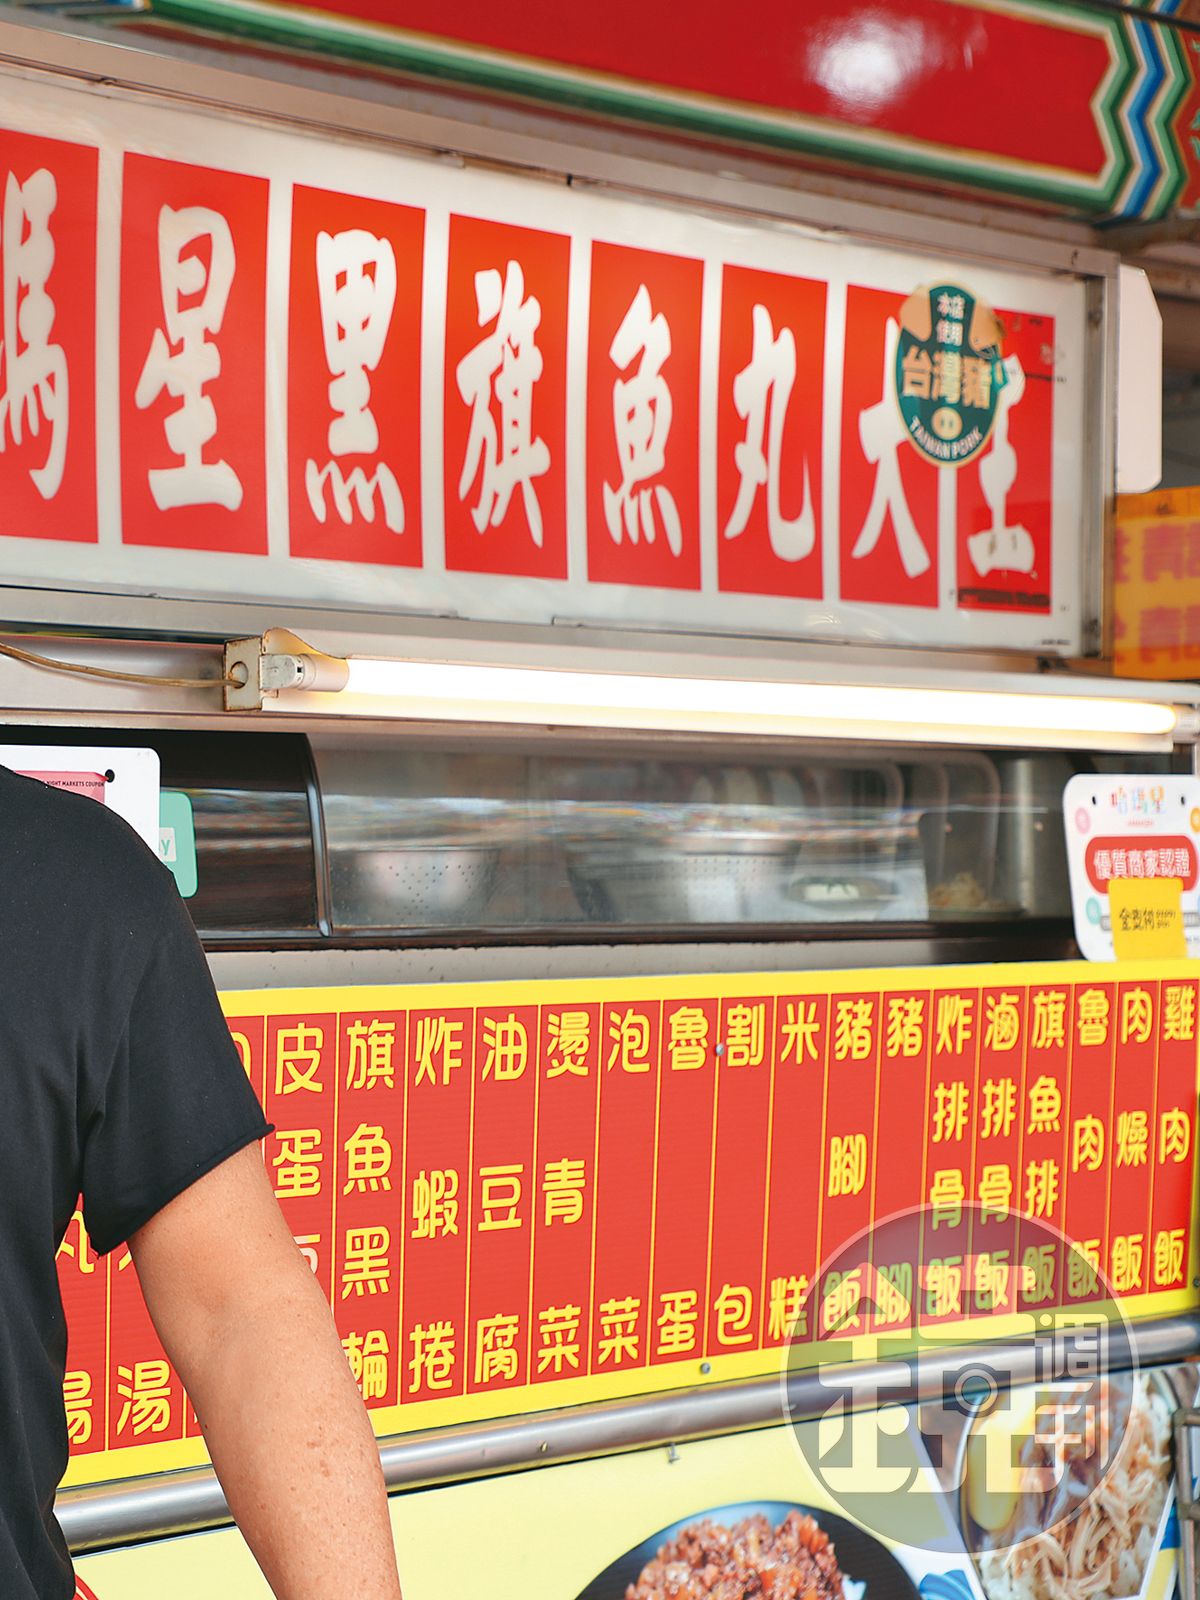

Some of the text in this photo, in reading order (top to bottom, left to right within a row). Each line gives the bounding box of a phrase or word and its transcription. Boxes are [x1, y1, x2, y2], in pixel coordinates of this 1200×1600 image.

[902, 345, 992, 410] 台灣豬
[909, 416, 983, 459] TAIWAN PORK
[1094, 848, 1191, 879] 優質商家認證
[341, 1019, 397, 1400] 旗魚黑輪
[409, 1017, 464, 1393] 炸蝦捲
[474, 1013, 529, 1383] 油豆腐
[537, 1011, 591, 1374] 燙青菜
[597, 1008, 651, 1365] 泡菜
[656, 1006, 709, 1355] 魯蛋
[713, 1003, 766, 1346] 割包
[768, 1001, 820, 1342] 米糕
[822, 998, 874, 1333] 豬腳飯
[874, 997, 925, 1327] 豬腳
[925, 994, 974, 1317] 炸排骨飯
[973, 992, 1020, 1311] 滷排骨飯
[1021, 990, 1067, 1304] 旗魚排飯
[1066, 988, 1111, 1298] 魯肉飯
[1111, 986, 1153, 1293] 肉燥飯
[1153, 985, 1196, 1286] 雞肉飯
